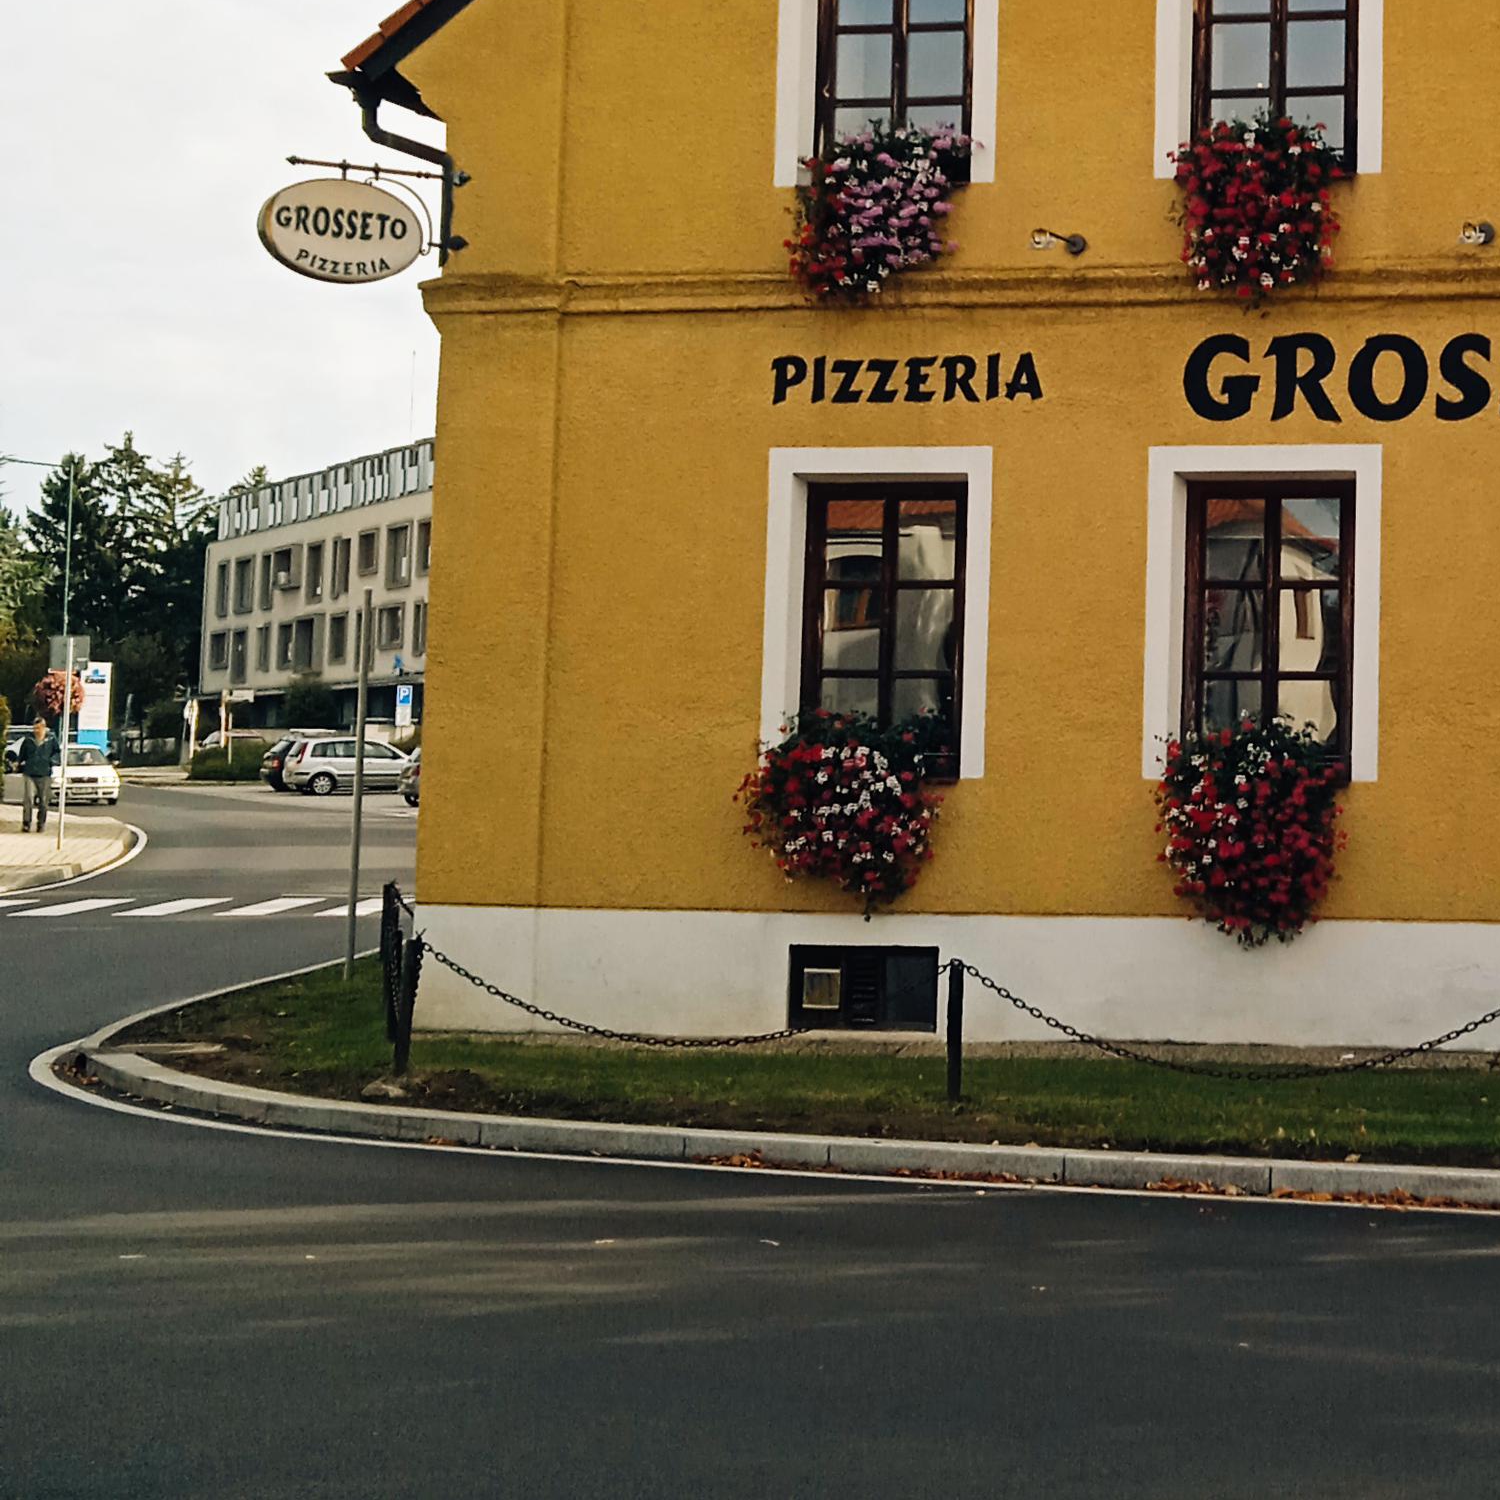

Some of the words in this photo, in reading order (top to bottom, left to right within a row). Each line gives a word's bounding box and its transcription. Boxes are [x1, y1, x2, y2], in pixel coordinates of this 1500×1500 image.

[275, 204, 408, 241] GROSSETO
[295, 248, 391, 276] PIZZERIA
[771, 351, 1044, 406] PIZZERIA
[400, 687, 410, 701] P
